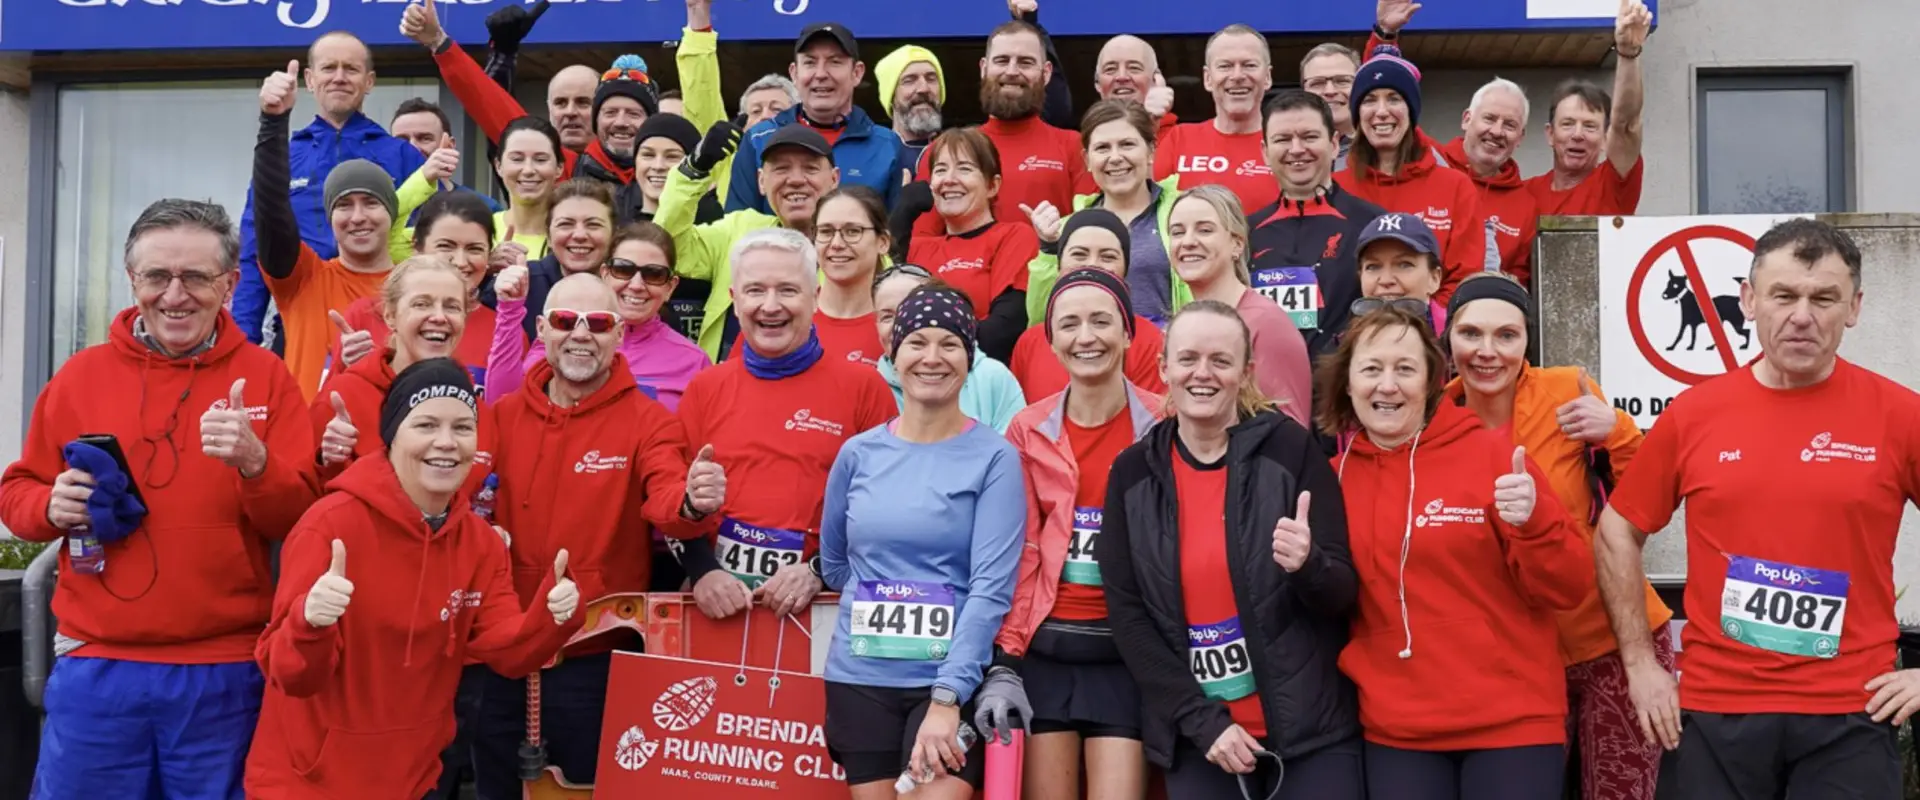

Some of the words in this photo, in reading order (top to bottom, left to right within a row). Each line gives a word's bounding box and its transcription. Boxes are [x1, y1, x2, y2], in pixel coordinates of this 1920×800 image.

[1177, 155, 1229, 173] LEO
[1260, 286, 1310, 310] 141
[1614, 397, 1642, 416] NO
[1719, 449, 1741, 462] Pat
[733, 523, 750, 538] Pop
[750, 529, 765, 542] Up
[1755, 562, 1780, 581] Pop
[1781, 567, 1802, 585] Up
[876, 584, 894, 597] Pop
[895, 584, 913, 597] Up
[1745, 587, 1842, 632] 4087
[868, 604, 950, 637] 4419
[1188, 628, 1203, 643] Pop
[1203, 628, 1219, 642] Up
[716, 712, 826, 748] BRENDA
[663, 737, 784, 772] RUNNING
[661, 767, 691, 779] NAAS,
